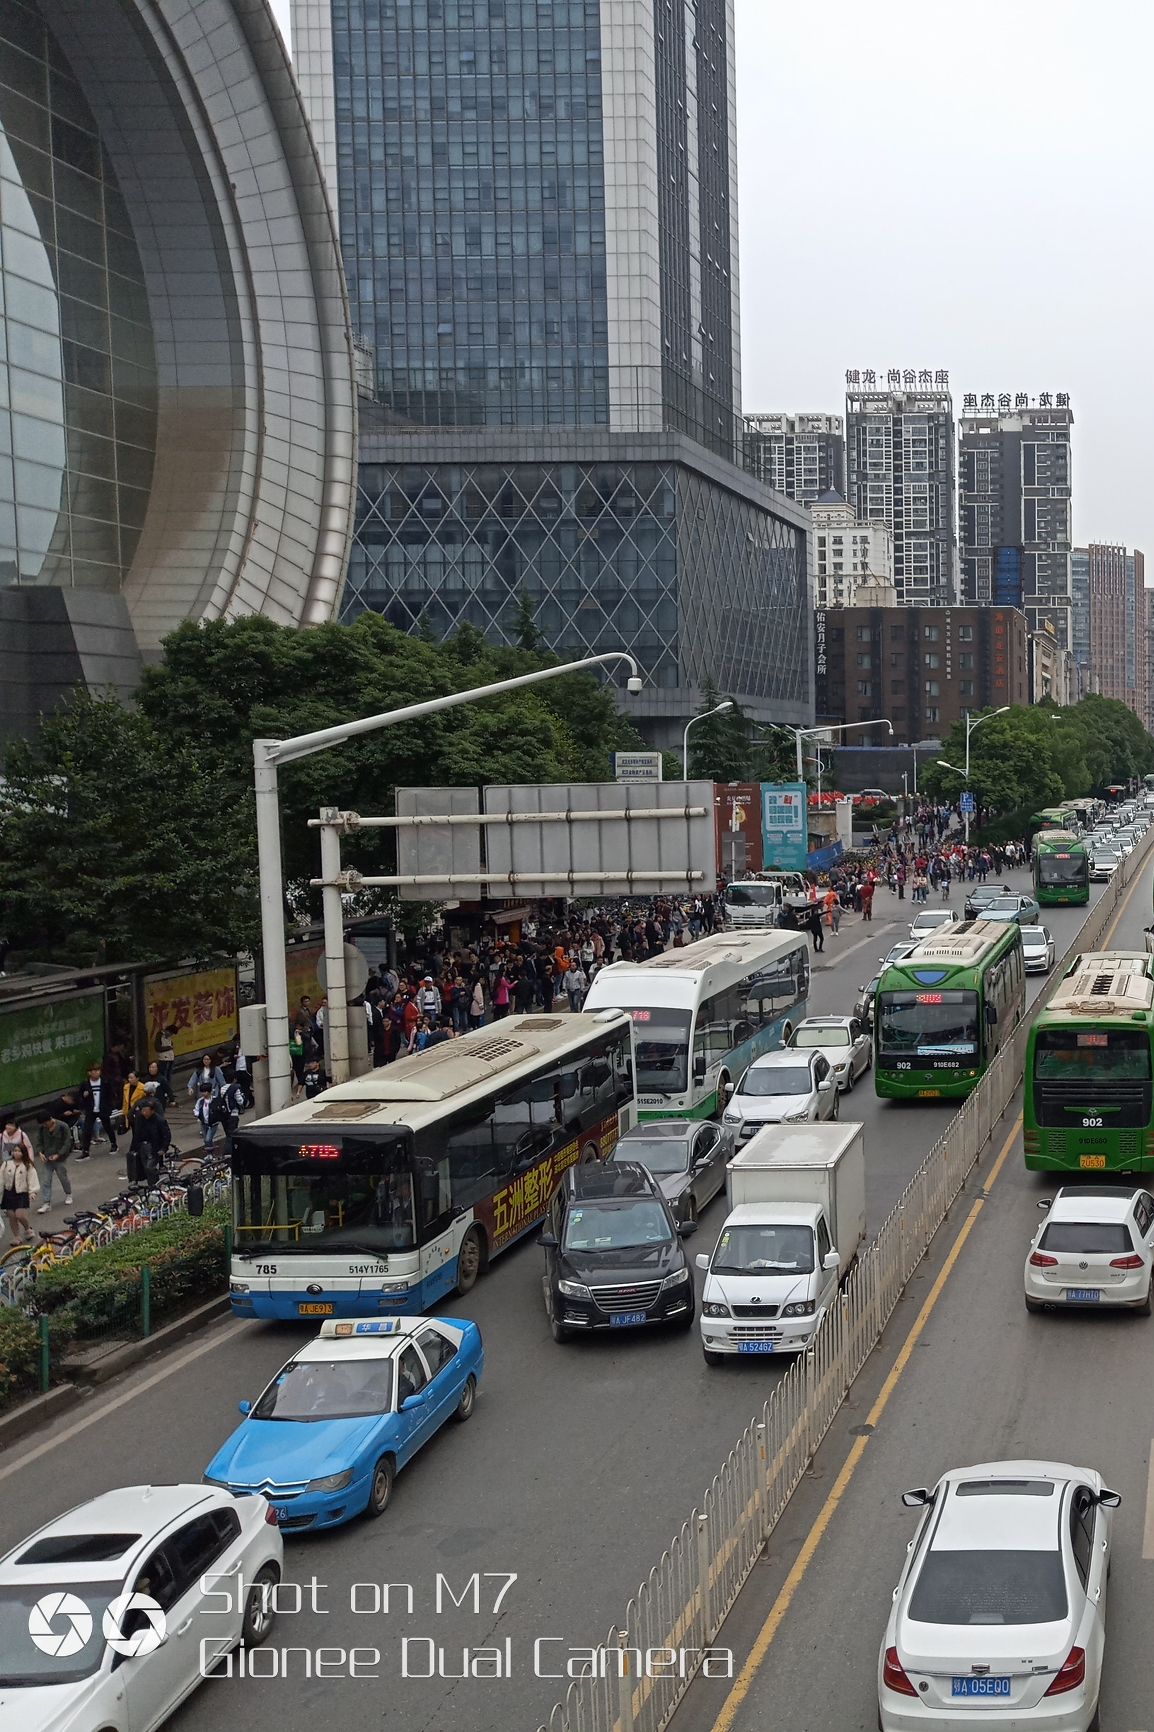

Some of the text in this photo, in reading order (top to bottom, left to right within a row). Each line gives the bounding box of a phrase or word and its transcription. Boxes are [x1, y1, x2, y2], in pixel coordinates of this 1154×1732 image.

[896, 1062, 911, 1070] 902
[1082, 1118, 1103, 1127] 902
[493, 1158, 553, 1237] 五洲整形
[255, 1264, 389, 1275] 785 514Y1765
